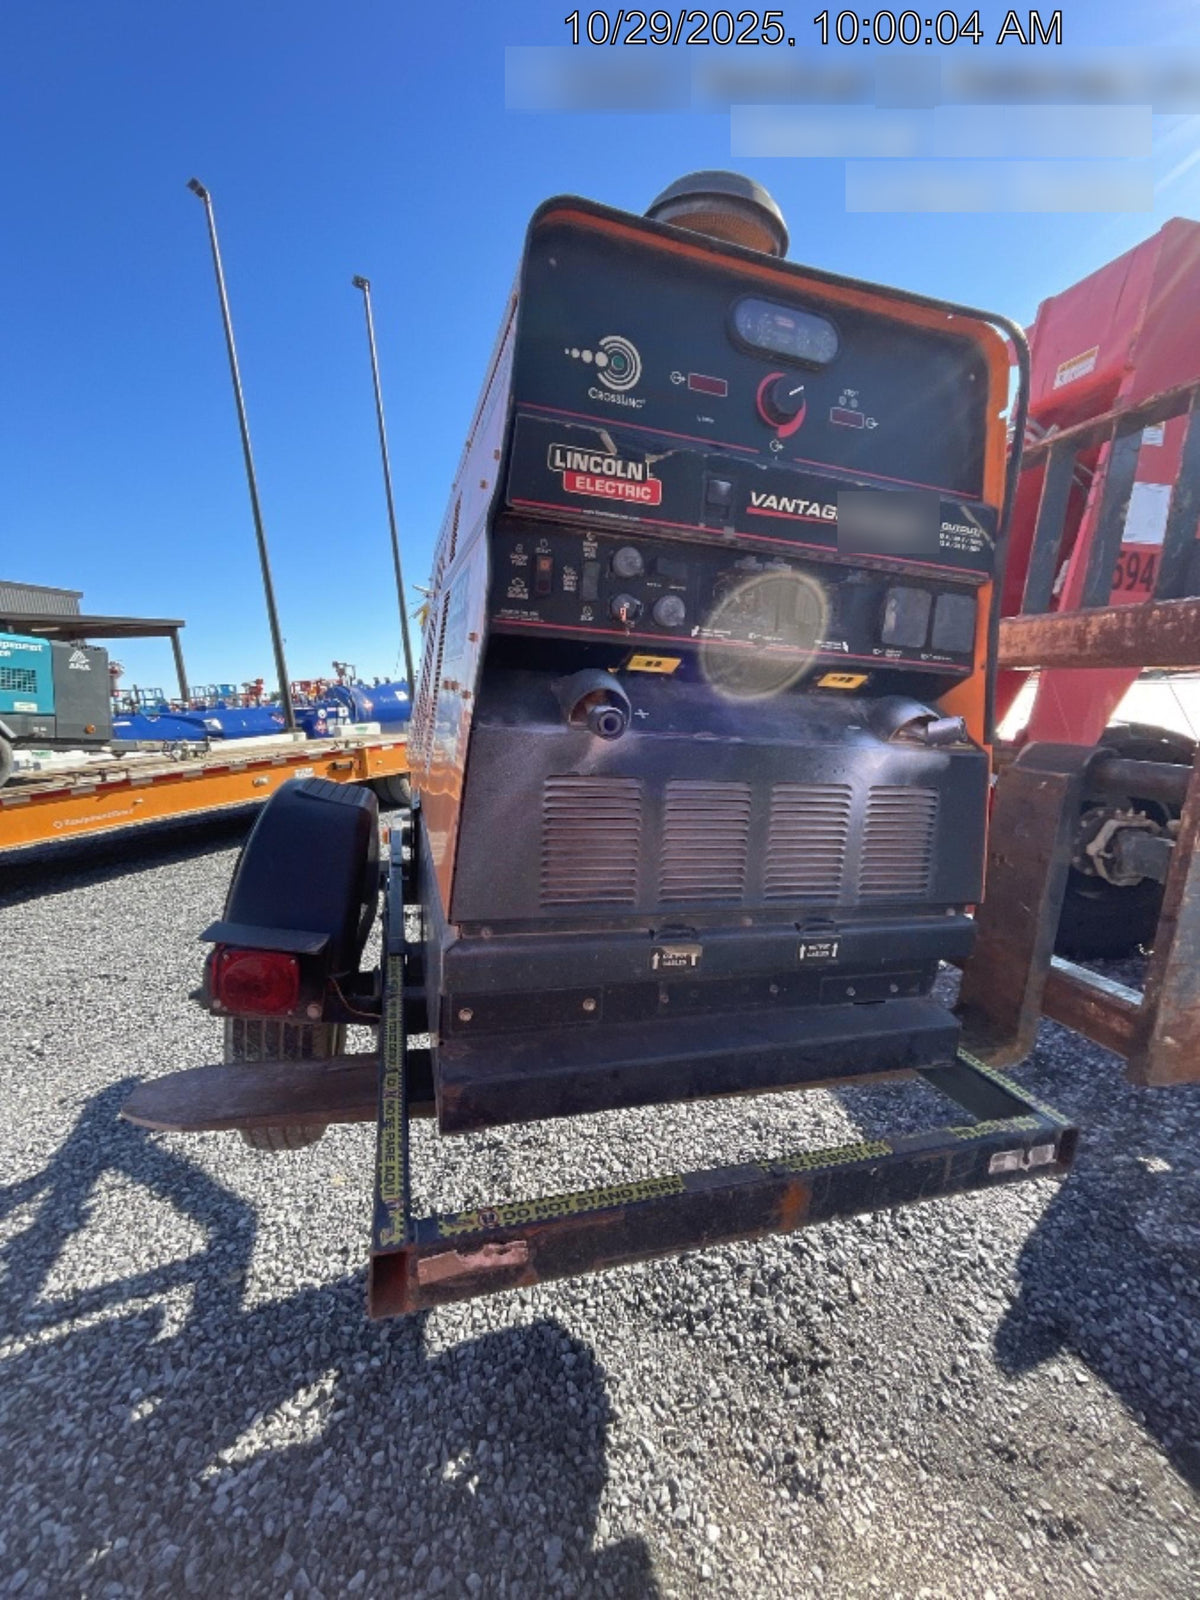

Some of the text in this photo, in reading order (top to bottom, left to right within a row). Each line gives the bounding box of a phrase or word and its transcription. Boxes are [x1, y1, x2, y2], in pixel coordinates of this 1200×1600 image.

[554, 449, 643, 480] LINCOLN
[575, 476, 652, 500] ELECTRIC
[750, 491, 838, 520] VANTAG
[385, 1132, 396, 1162] PARE
[503, 1179, 682, 1220] DO NOT STAND HERE
